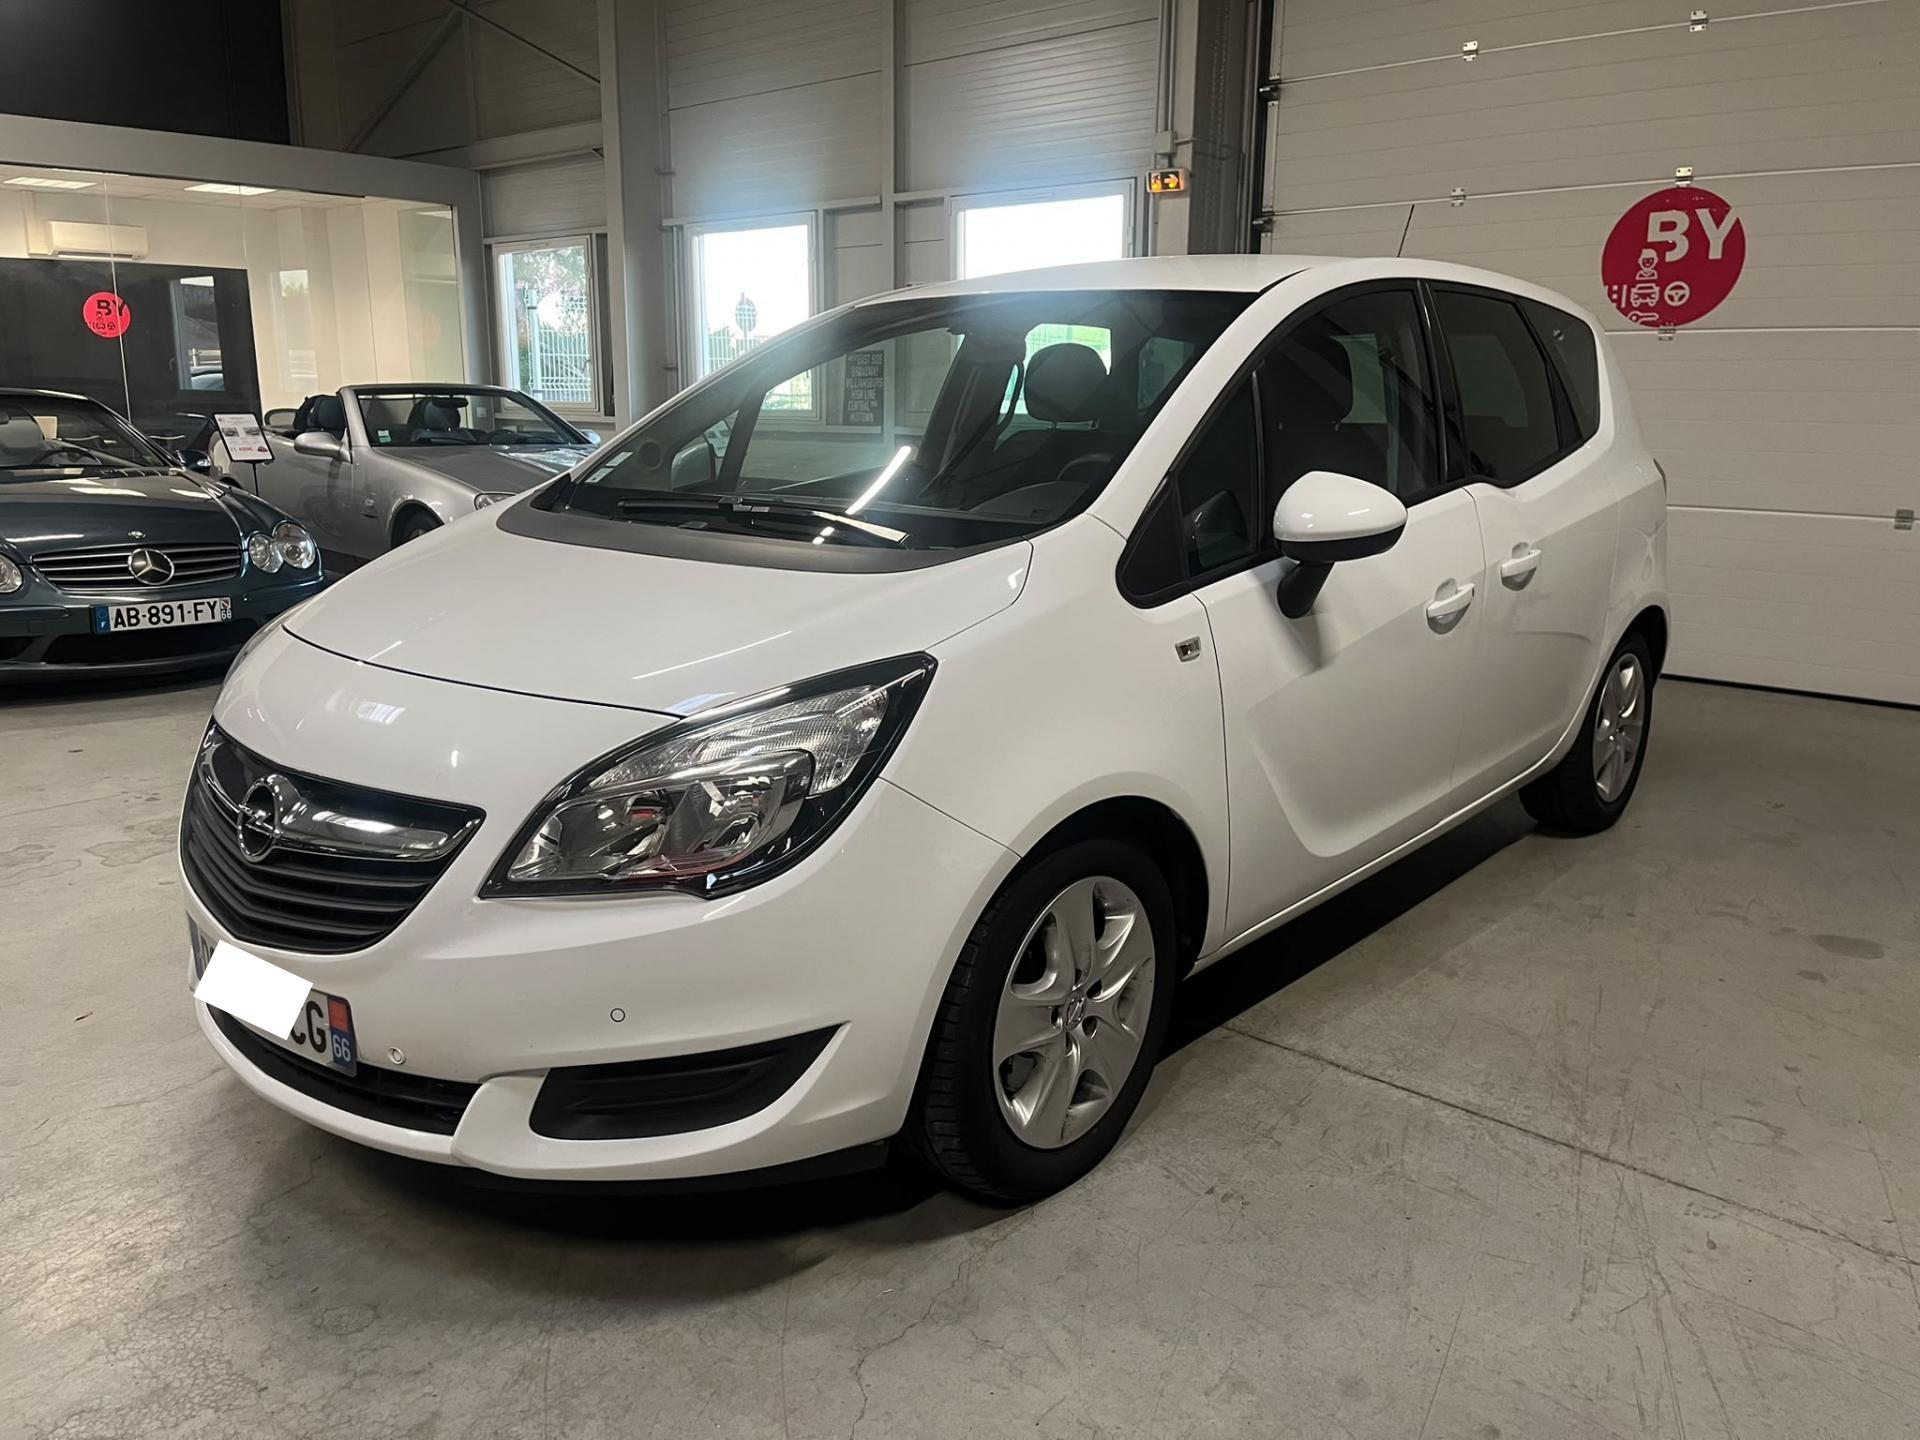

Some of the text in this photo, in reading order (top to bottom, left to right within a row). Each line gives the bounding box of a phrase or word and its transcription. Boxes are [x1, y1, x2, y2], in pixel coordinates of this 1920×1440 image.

[1647, 208, 1738, 262] BY
[97, 299, 125, 316] BY
[113, 600, 218, 629] AB-891-FY
[221, 609, 232, 620] 68
[332, 1034, 351, 1062] 66
